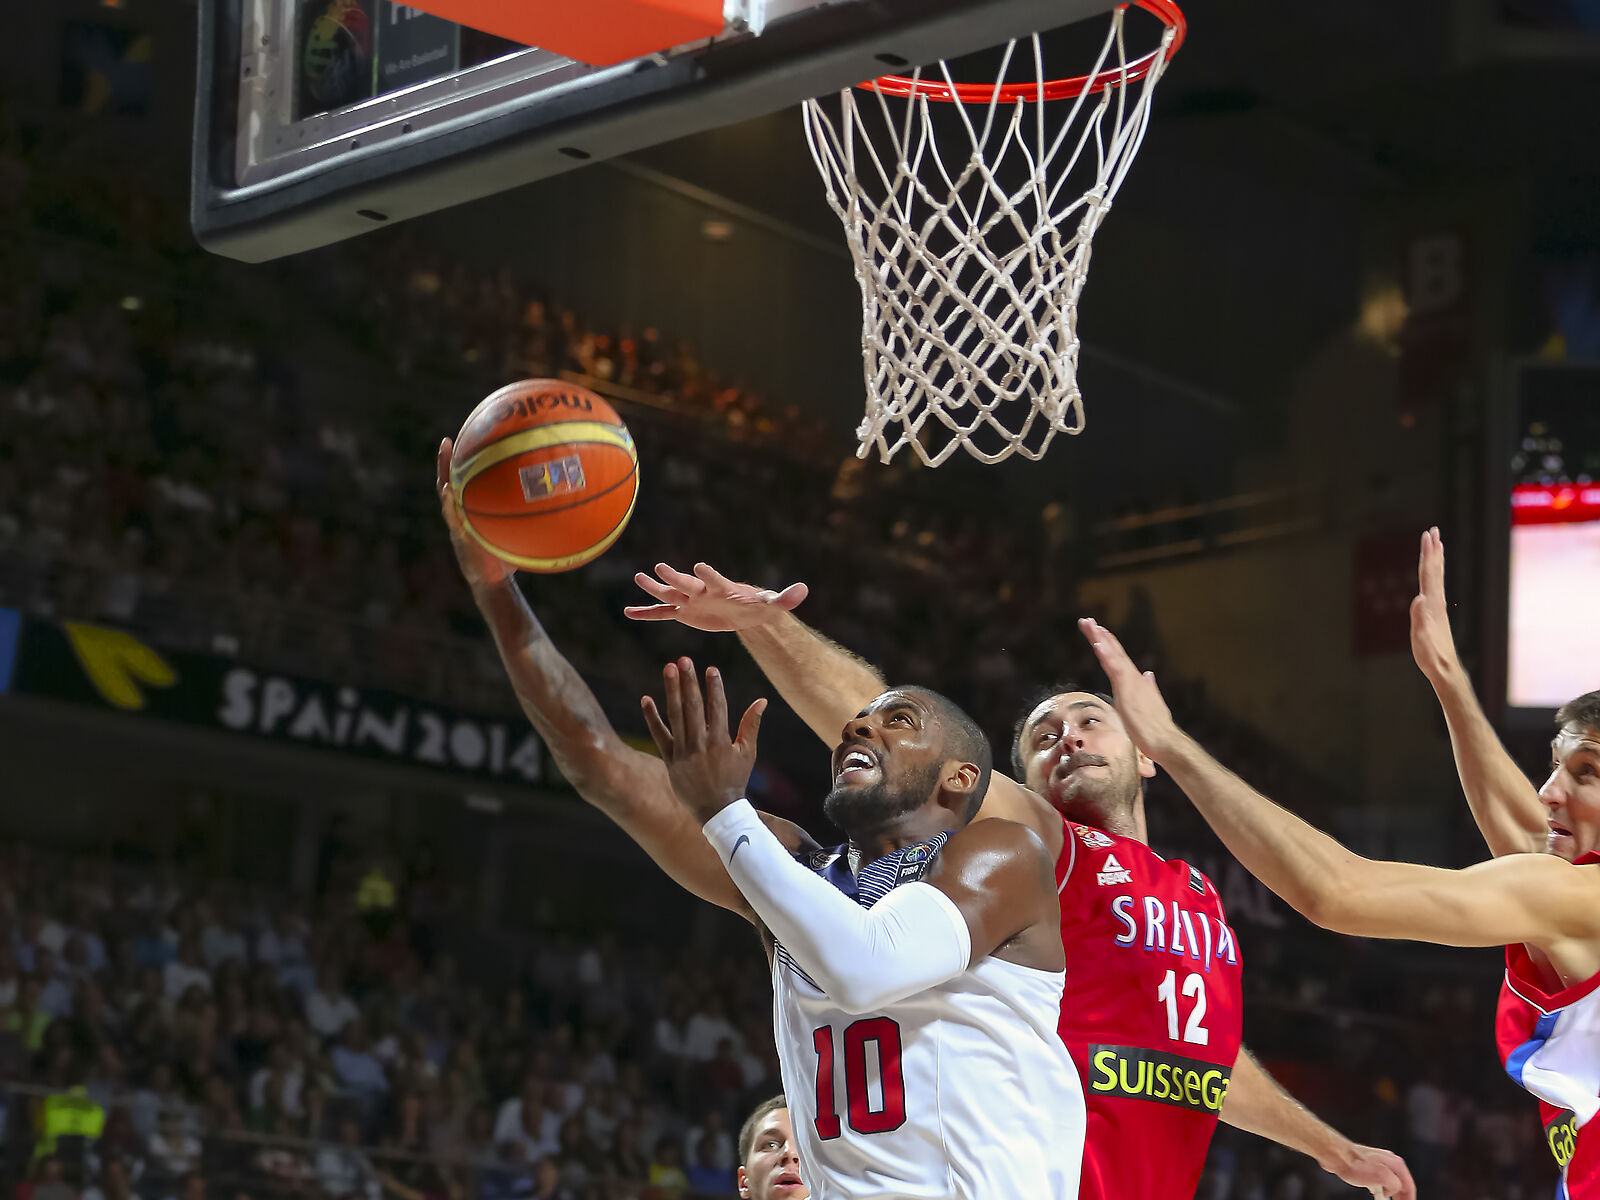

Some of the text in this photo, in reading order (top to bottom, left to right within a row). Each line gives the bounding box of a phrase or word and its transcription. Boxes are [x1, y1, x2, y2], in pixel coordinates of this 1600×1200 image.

[413, 712, 542, 781] 2014
[900, 865, 919, 878] FIBA
[1096, 869, 1133, 886] PEAK
[1157, 969, 1209, 1046] 12
[812, 1016, 908, 1141] 10
